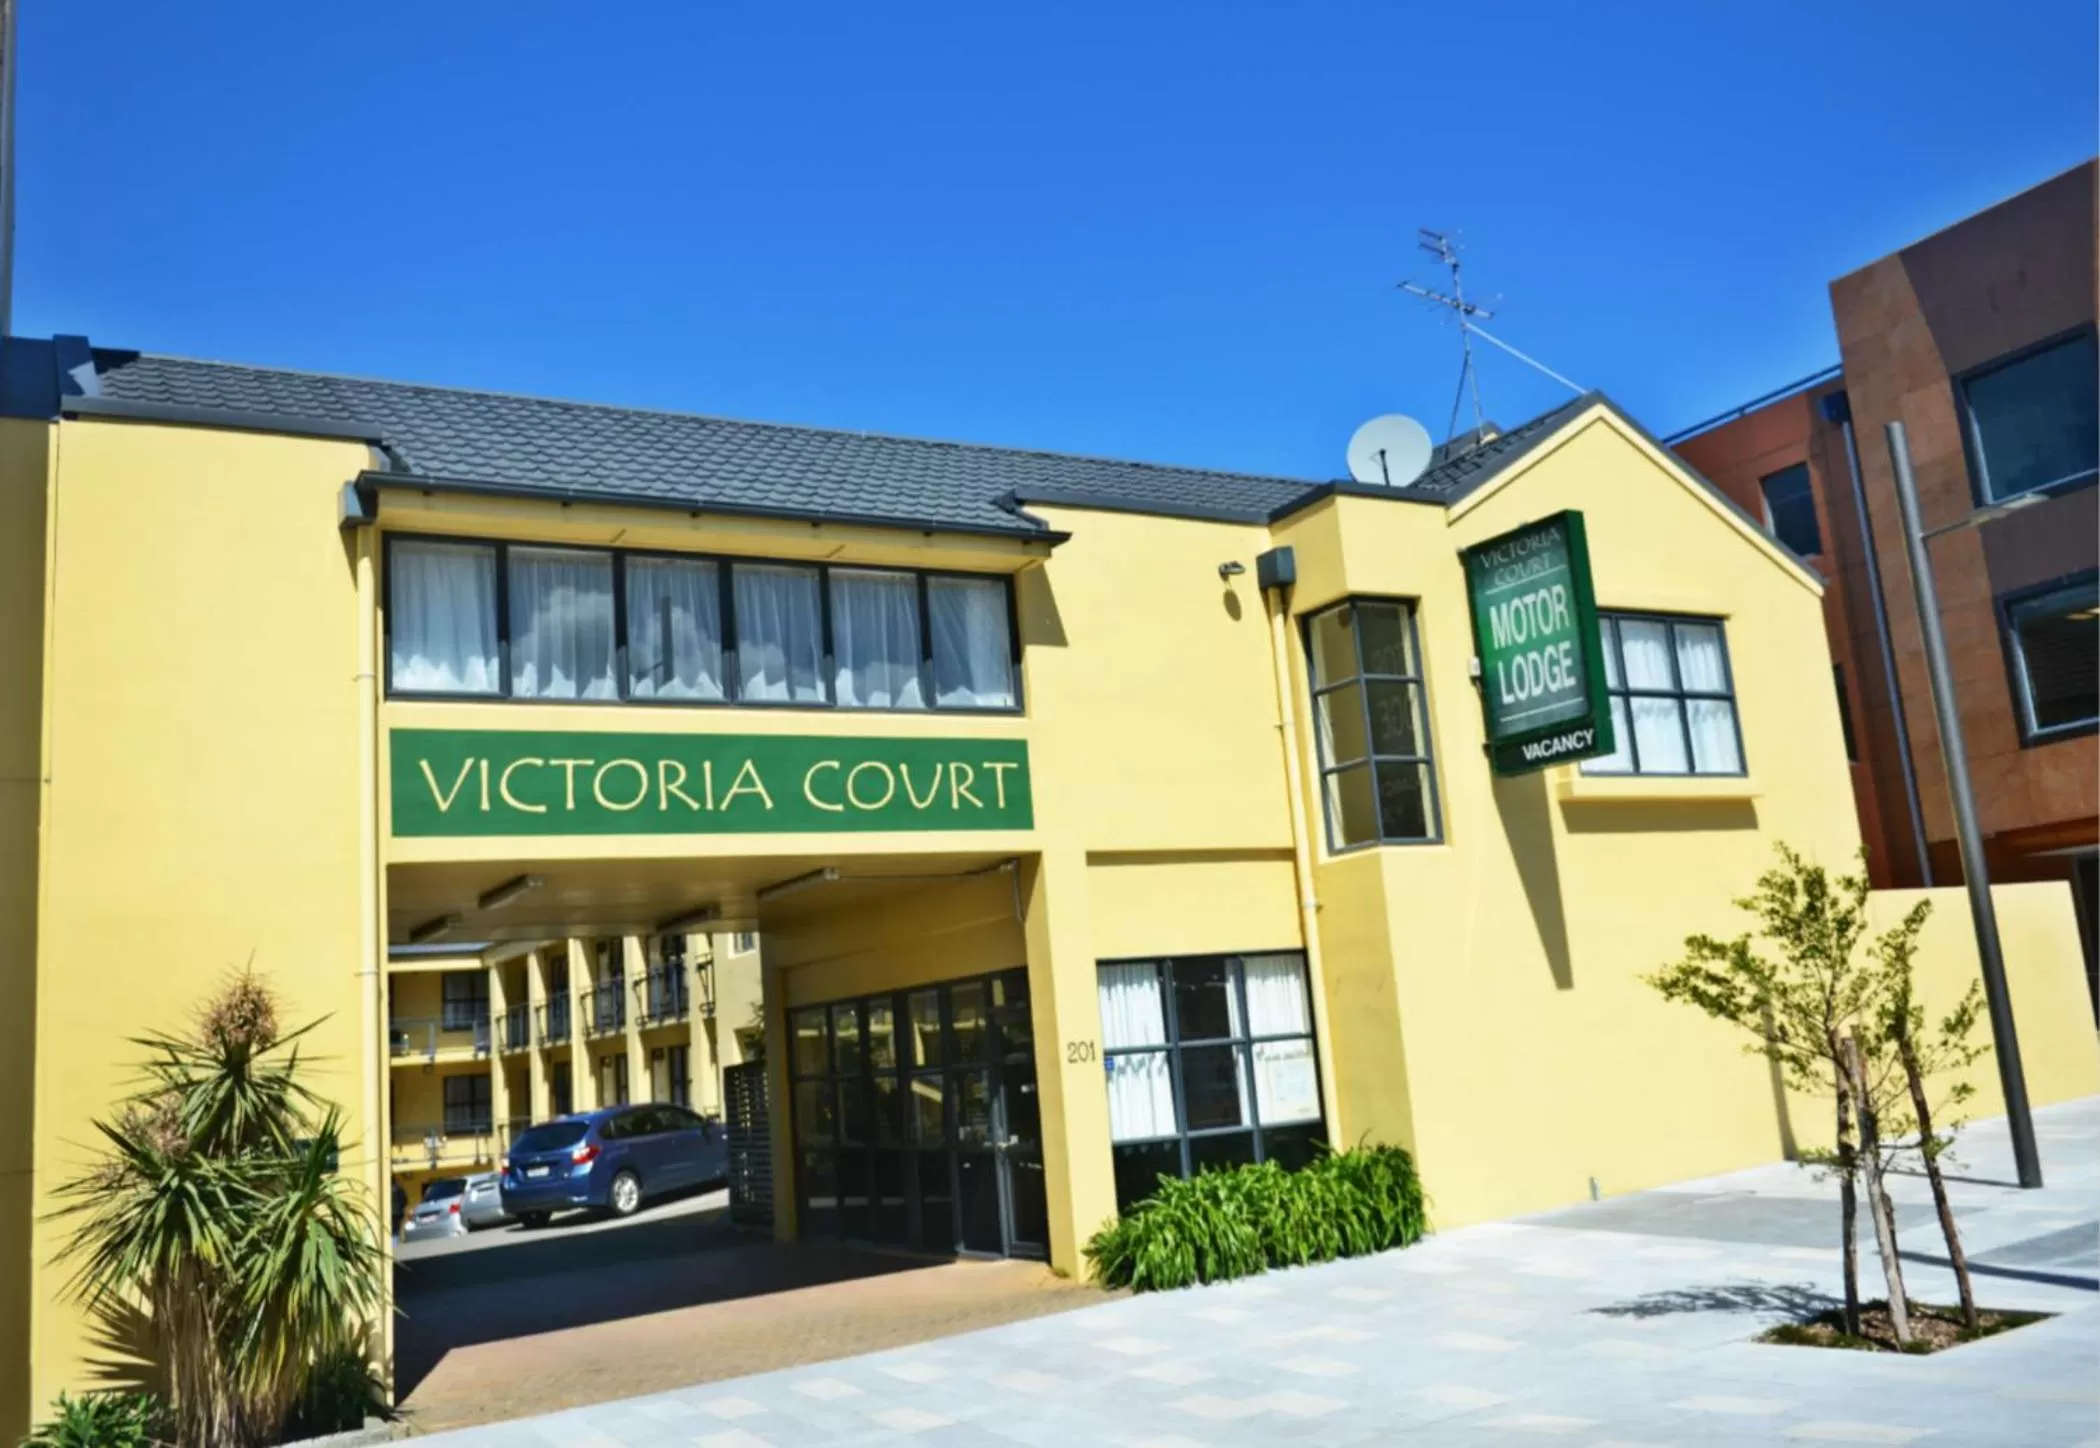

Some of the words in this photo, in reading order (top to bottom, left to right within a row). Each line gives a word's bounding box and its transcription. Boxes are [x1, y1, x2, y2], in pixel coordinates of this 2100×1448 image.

[1480, 527, 1561, 569] VICTORIA
[1493, 552, 1553, 587] COURT
[1489, 583, 1571, 650] MOTOR
[1498, 641, 1577, 705] LODGE
[1521, 728, 1595, 761] VACANCY
[419, 757, 774, 813] VICTORIA
[802, 760, 1019, 812] COURT
[1067, 1041, 1096, 1064] 201
